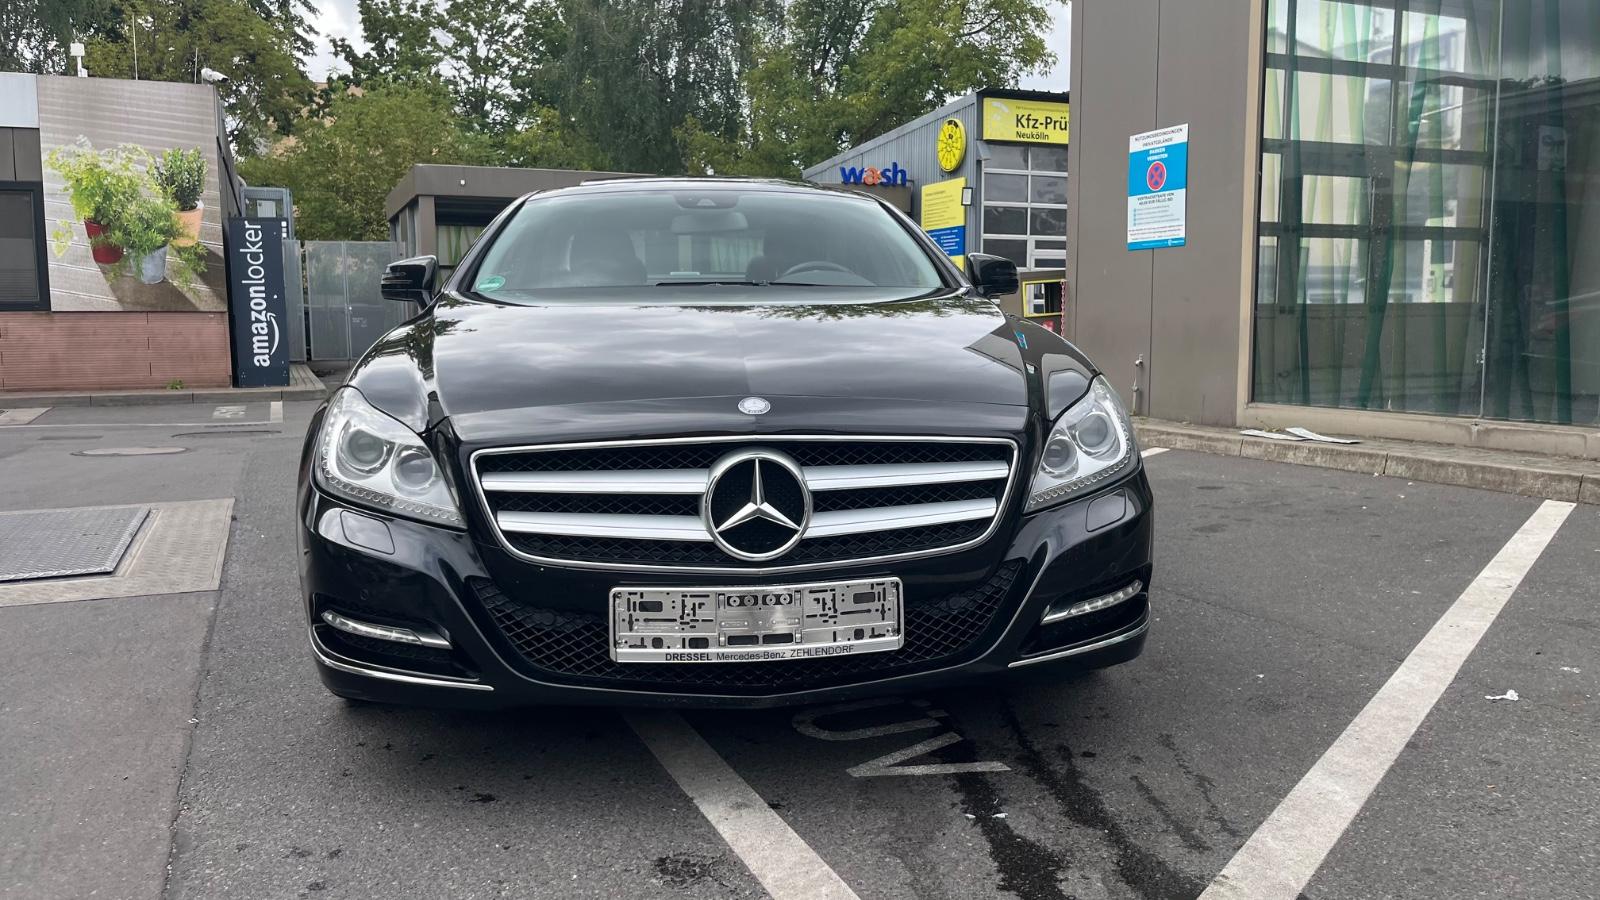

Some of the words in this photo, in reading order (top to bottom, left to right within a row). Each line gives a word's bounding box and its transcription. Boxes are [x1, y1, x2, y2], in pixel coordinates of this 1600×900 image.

[1016, 113, 1069, 132] Kfz-Prü
[1016, 131, 1049, 141] Neukölln
[840, 162, 907, 187] wash
[665, 653, 712, 662] DRESSEL
[716, 651, 786, 662] Mercedes-Benz
[790, 645, 855, 658] ZEHLENDORF
